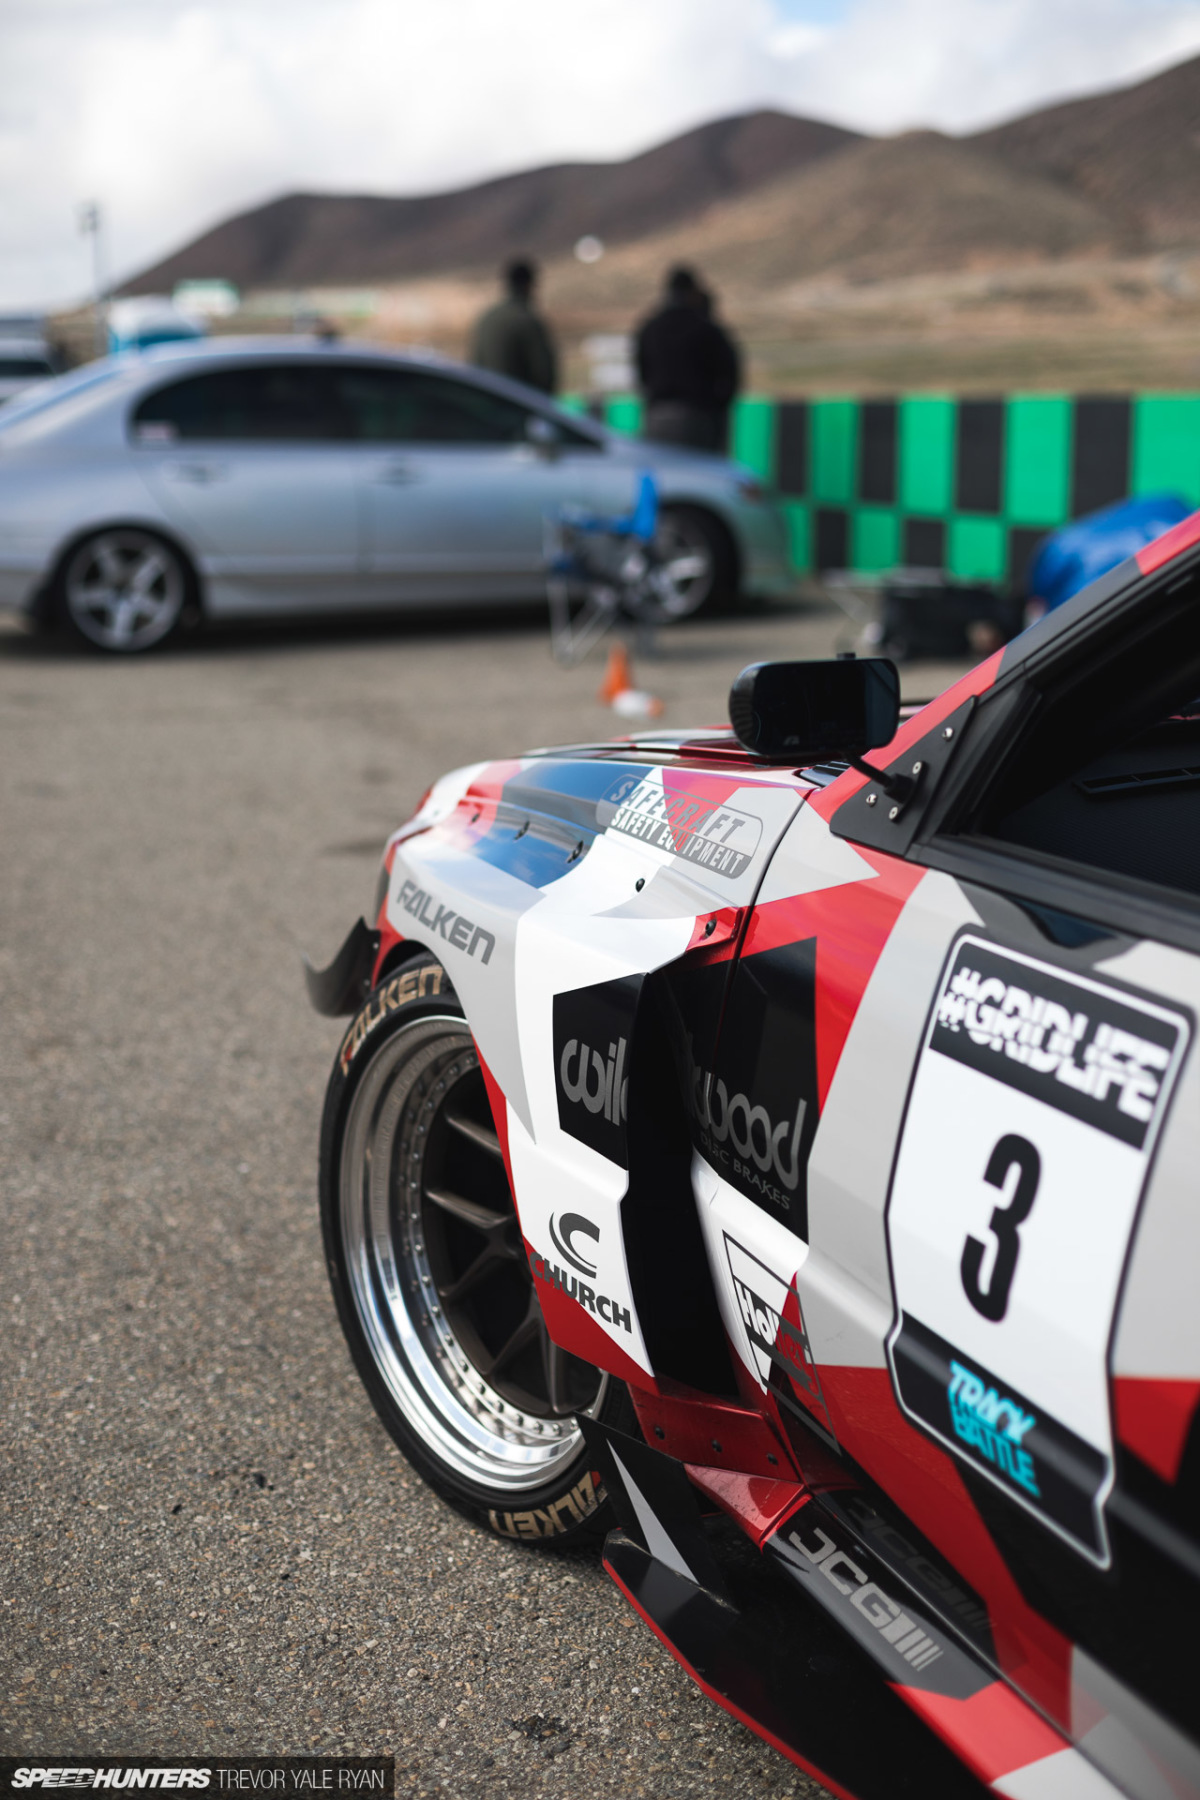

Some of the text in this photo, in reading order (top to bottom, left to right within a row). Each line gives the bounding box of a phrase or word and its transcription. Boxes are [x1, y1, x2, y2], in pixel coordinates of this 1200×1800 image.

[610, 781, 746, 844] SAFECRAFT
[611, 808, 745, 875] SAFETY EQUIPMENT
[396, 880, 496, 966] FALKEN
[340, 964, 444, 1077] FALKEN
[560, 1036, 628, 1127] wil
[732, 1160, 792, 1211] BRAKES
[960, 1133, 1042, 1324] 3
[529, 1251, 633, 1334] CHURCH
[734, 1278, 821, 1398] Holley
